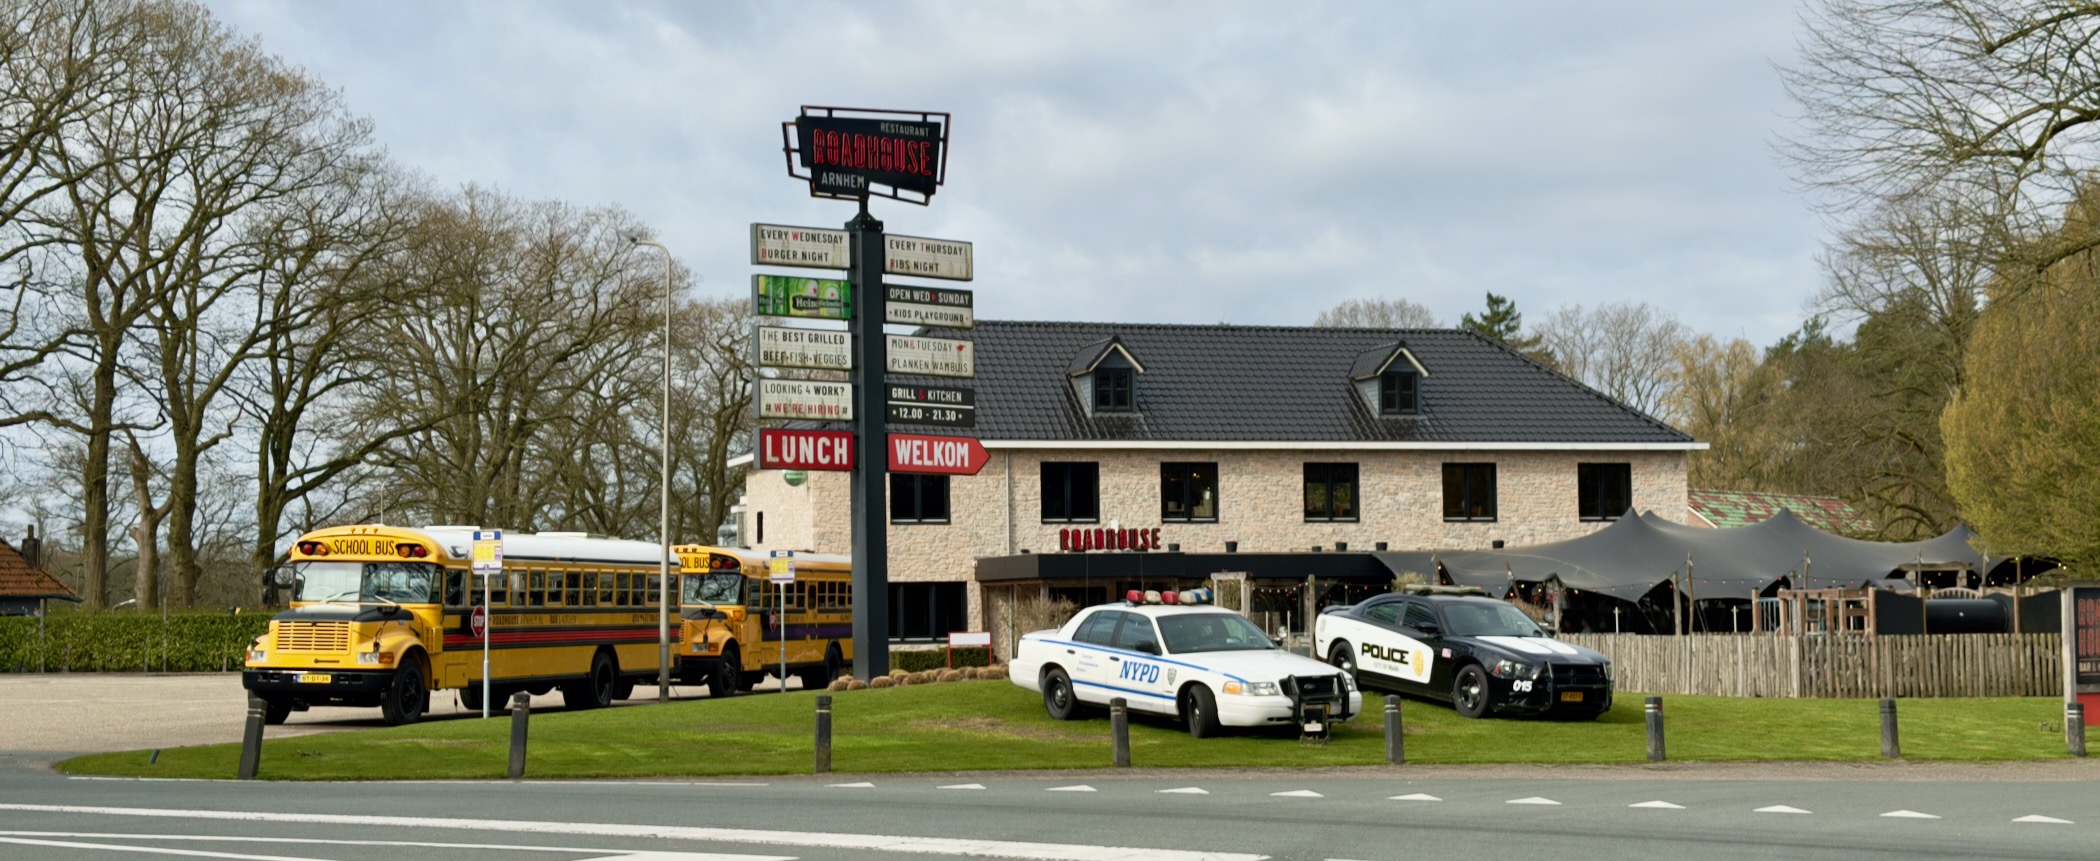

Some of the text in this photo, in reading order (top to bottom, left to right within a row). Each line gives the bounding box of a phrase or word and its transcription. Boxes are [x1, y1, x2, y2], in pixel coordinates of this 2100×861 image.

[880, 122, 930, 137] RESTAURANT
[813, 129, 932, 176] ROADHOUSE
[821, 172, 865, 189] ARNHEM
[761, 229, 843, 244] EVERY WEDNESDAY
[762, 248, 828, 262] BURGER NIGHT
[890, 240, 962, 256] EVERY THURSDAY
[890, 258, 939, 272] RIBS NIGHT
[890, 288, 970, 304] OPEN WED SUNDAY
[894, 308, 964, 322] KIDS PLAYGROUND
[762, 330, 844, 344] THE BEST GRILLED
[892, 358, 968, 373] PLANKEN WAMBUIS
[765, 384, 844, 396] LOOKING 4 WORK?
[892, 388, 962, 402] GRILL & KITCHEN
[774, 402, 804, 414] WE'RE
[808, 404, 840, 416] HIRING
[899, 408, 922, 419] 12.00
[932, 410, 956, 422] 21.30
[766, 434, 848, 465] LUNCH
[895, 439, 969, 468] WELKOM
[334, 540, 394, 555] SCHOOL BUS
[1060, 528, 1161, 552] ROADHOUSE
[694, 556, 709, 568] BUS
[1362, 642, 1409, 665] POLICE
[1120, 660, 1160, 684] NYPD
[1512, 680, 1532, 692] 015
